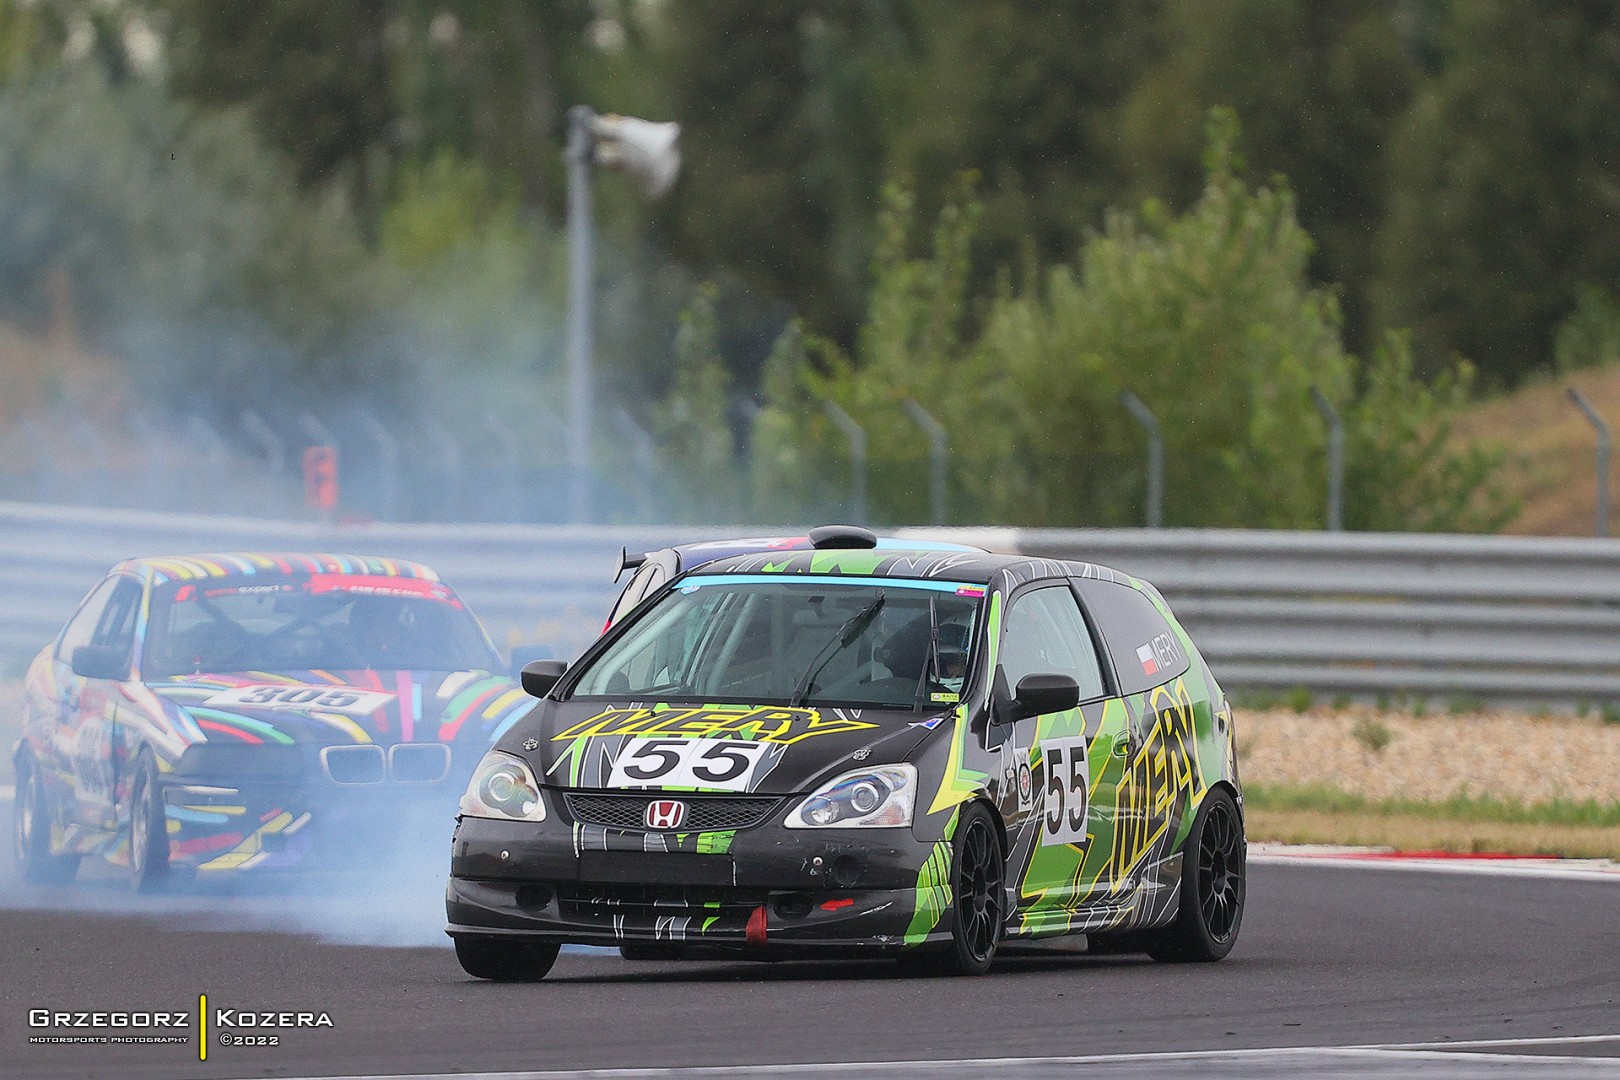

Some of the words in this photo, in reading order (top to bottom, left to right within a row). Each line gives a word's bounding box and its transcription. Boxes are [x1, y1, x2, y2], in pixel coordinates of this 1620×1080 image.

[1147, 630, 1182, 671] MERY
[238, 686, 369, 707] 305
[624, 739, 759, 782] 55
[1046, 746, 1086, 835] 55
